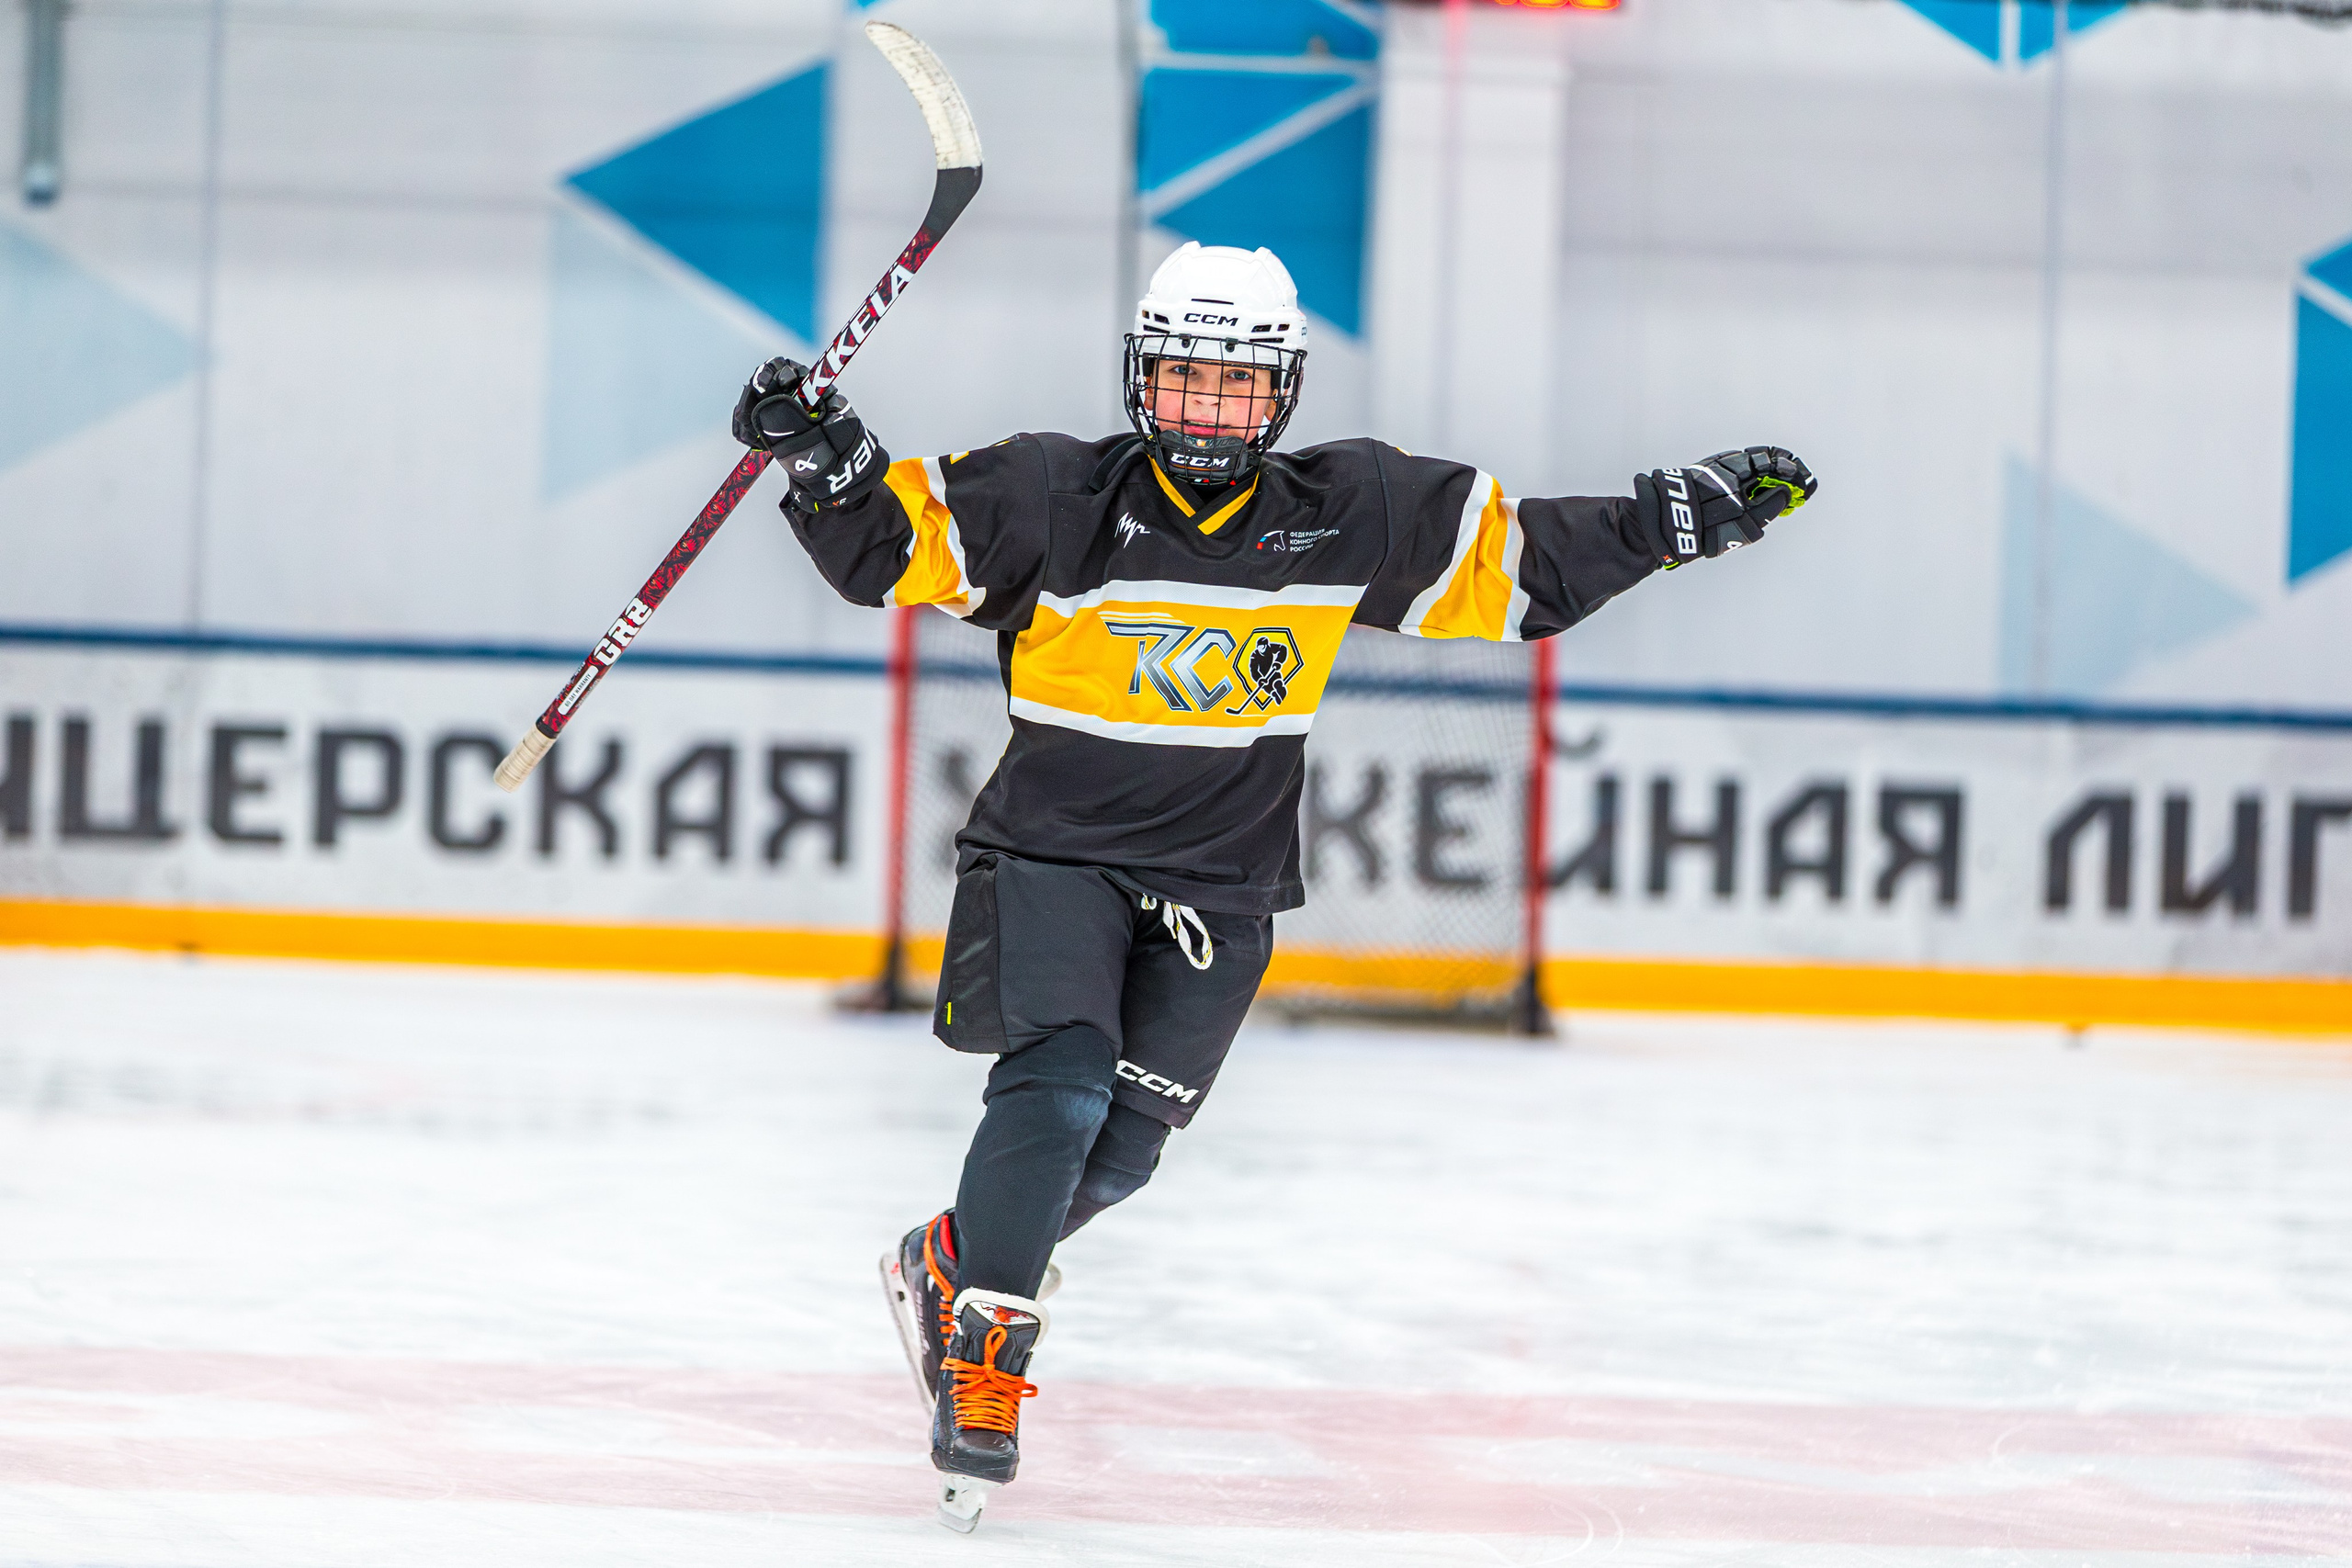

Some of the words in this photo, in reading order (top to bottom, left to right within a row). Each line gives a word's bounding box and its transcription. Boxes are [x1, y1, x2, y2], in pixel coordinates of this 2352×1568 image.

[1183, 312, 1238, 327] CCM
[797, 265, 915, 406] KKELA
[1170, 453, 1230, 468] CCM
[1289, 536, 1317, 546] КОННОГО
[574, 673, 592, 694] WARRANTY
[1115, 1059, 1199, 1103] CCM
